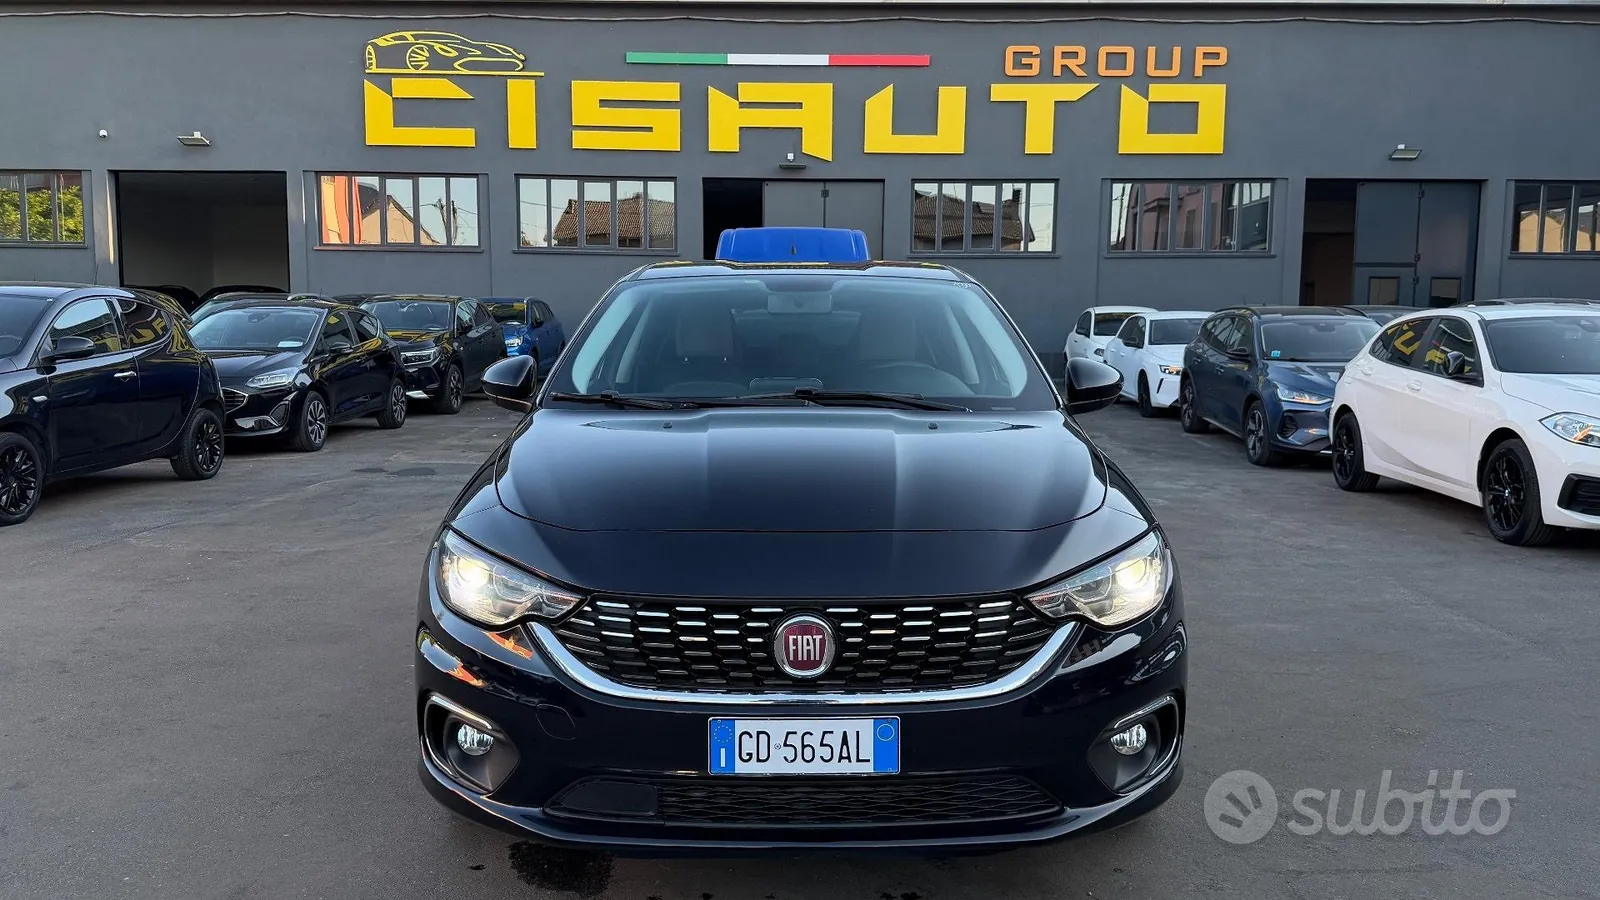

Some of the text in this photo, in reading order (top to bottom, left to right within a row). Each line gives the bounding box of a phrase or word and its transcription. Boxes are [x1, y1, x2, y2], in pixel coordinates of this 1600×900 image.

[1004, 45, 1228, 77] GROUP
[364, 77, 1227, 161] CISAUTO
[788, 635, 823, 661] FIAT
